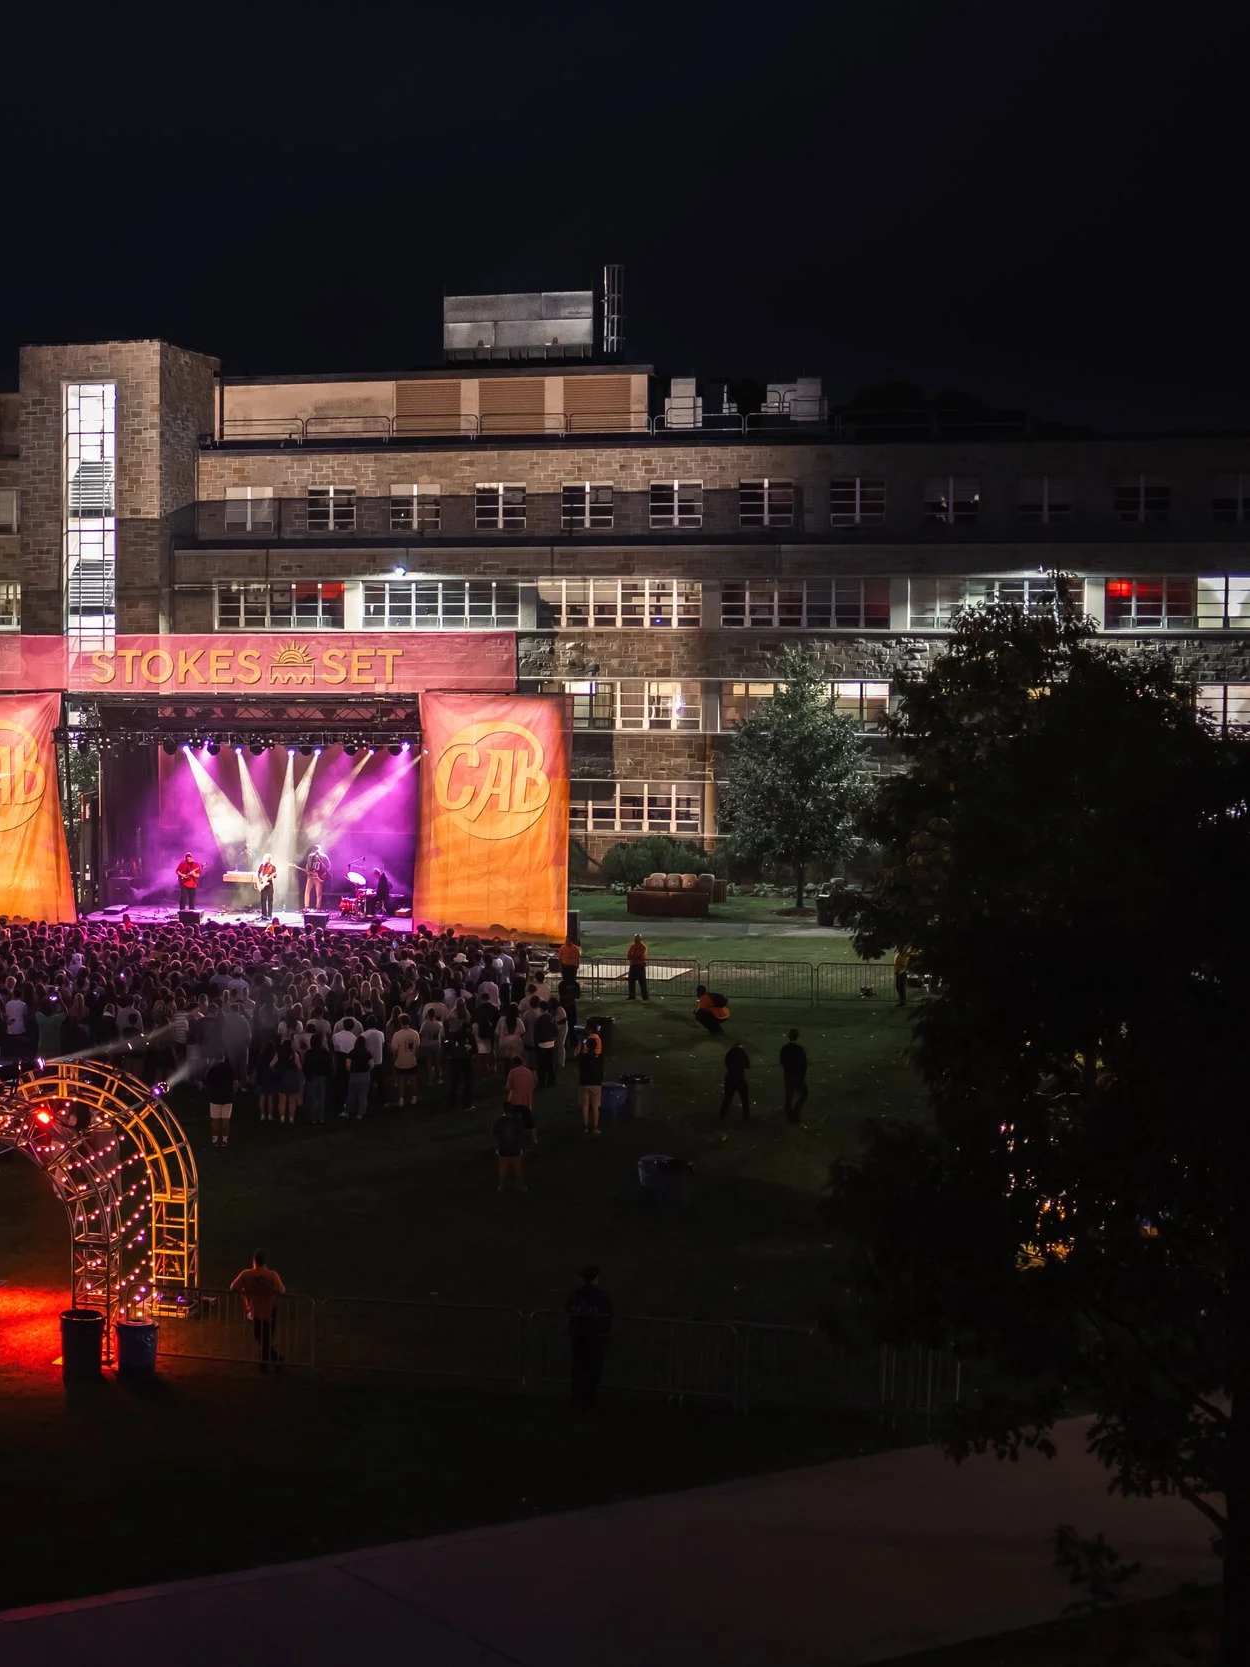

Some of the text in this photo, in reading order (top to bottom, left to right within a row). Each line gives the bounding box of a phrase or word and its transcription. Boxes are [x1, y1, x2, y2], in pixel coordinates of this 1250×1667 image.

[90, 649, 404, 684] STOKES SET
[435, 742, 551, 822] CAB
